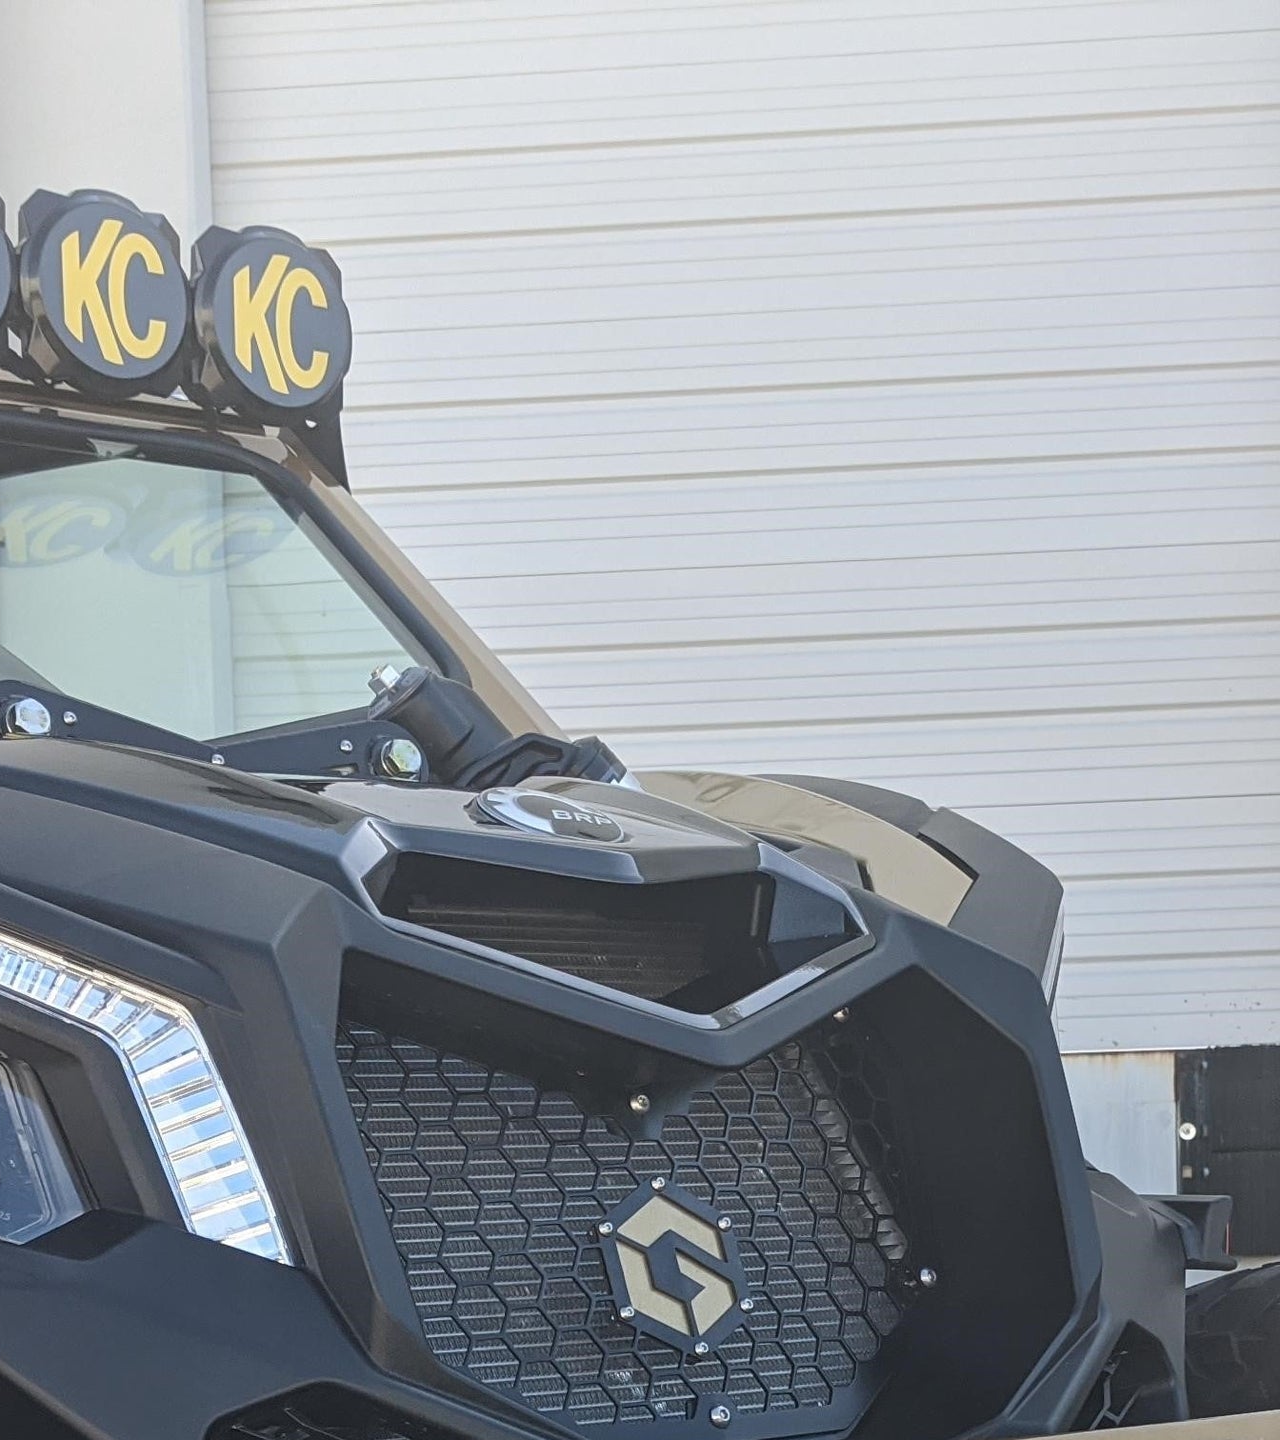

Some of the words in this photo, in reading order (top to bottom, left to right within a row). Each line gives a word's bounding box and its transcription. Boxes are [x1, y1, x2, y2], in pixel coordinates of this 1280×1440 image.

[61, 219, 166, 365] KC
[233, 254, 329, 394] KC
[551, 809, 612, 825] BRP
